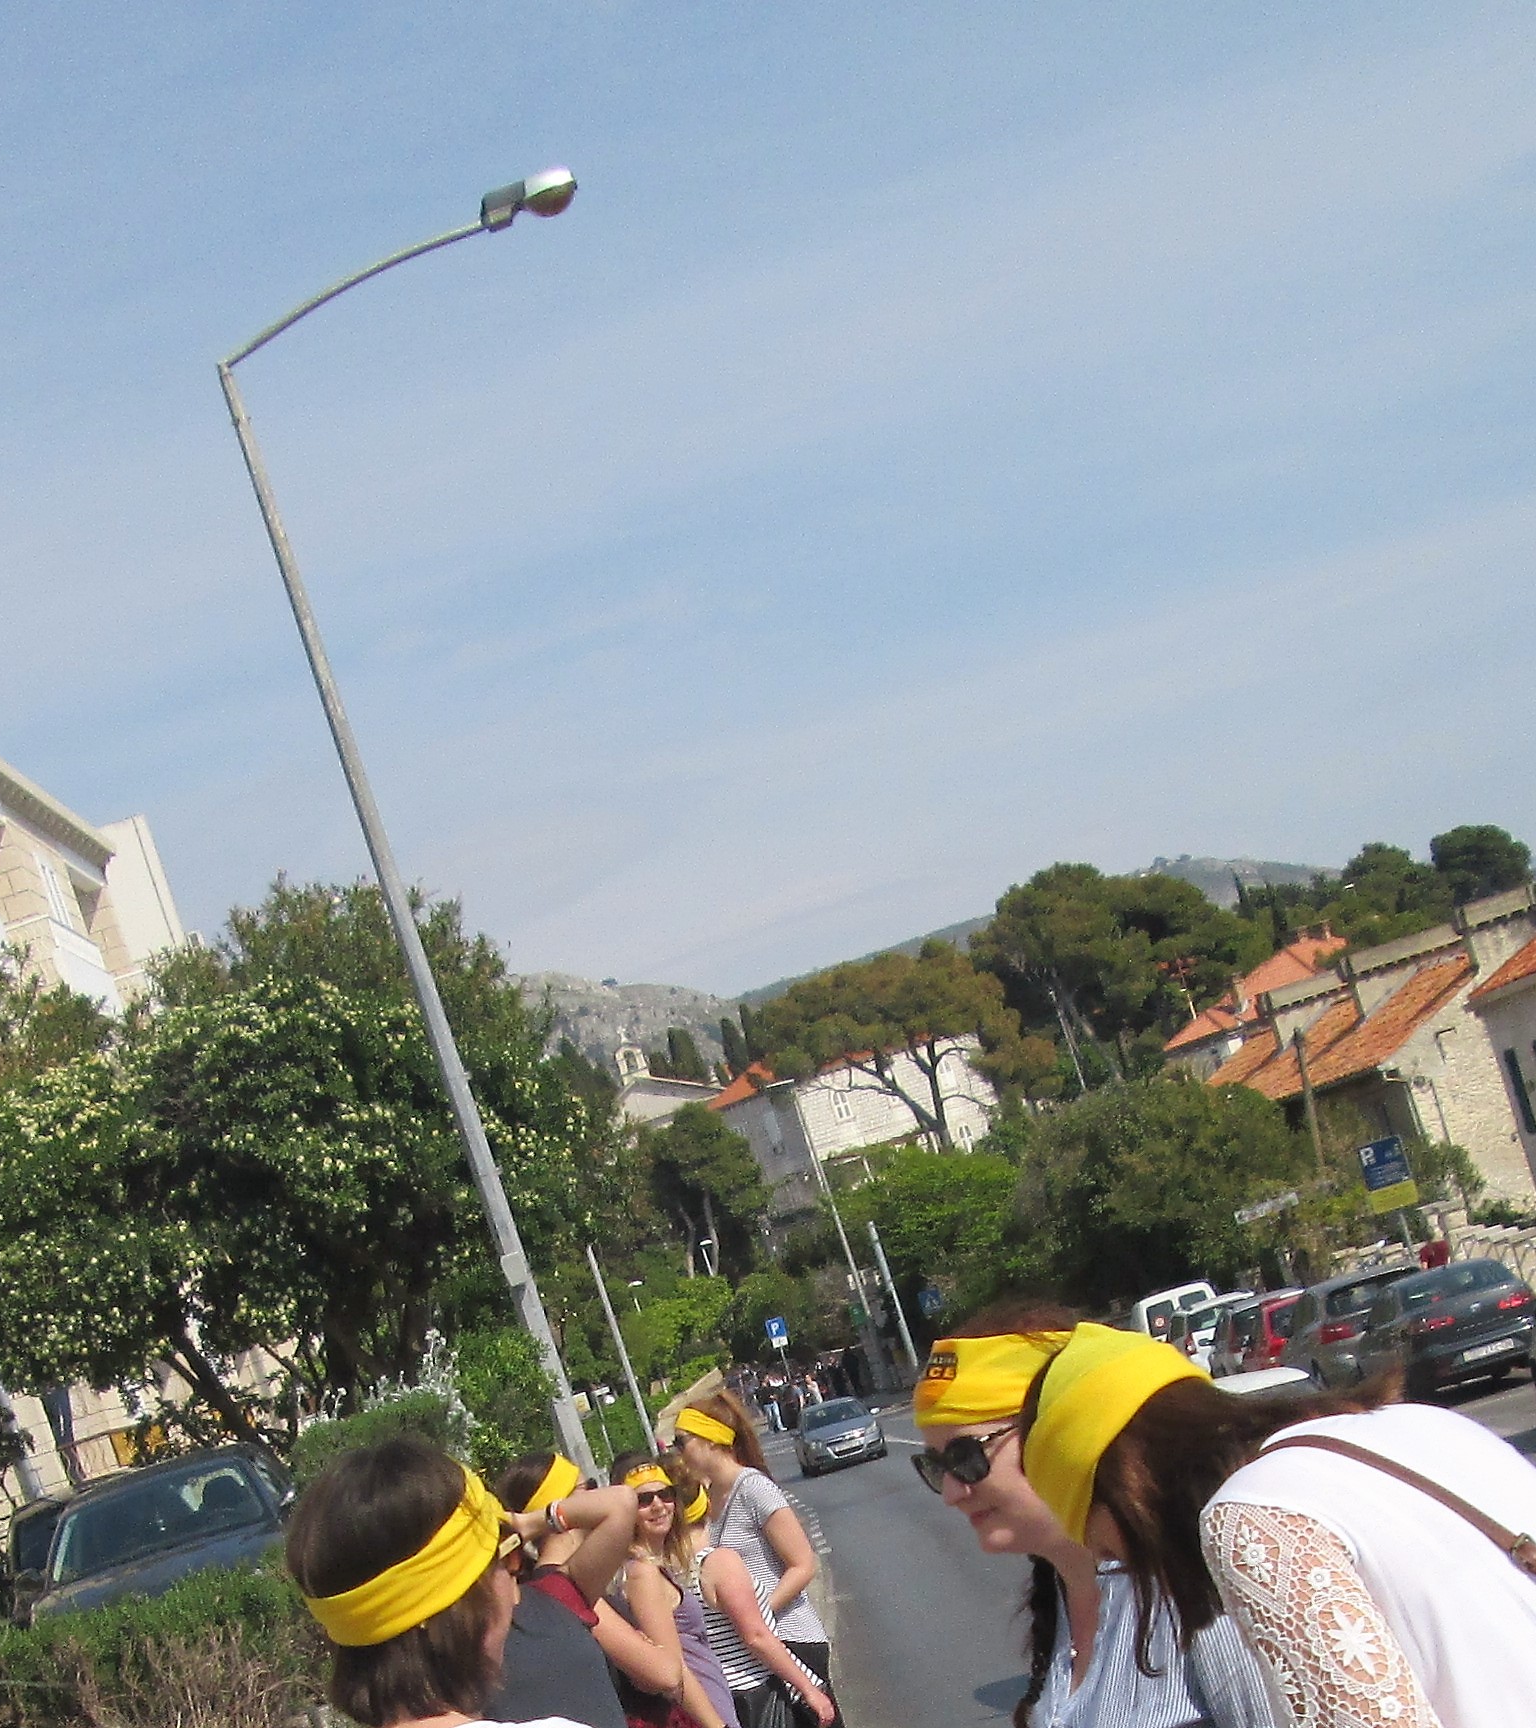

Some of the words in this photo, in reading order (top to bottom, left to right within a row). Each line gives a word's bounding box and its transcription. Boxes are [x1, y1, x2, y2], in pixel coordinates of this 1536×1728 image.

[1360, 1146, 1373, 1167] P
[770, 1322, 780, 1336] P
[927, 1366, 956, 1379] CE
